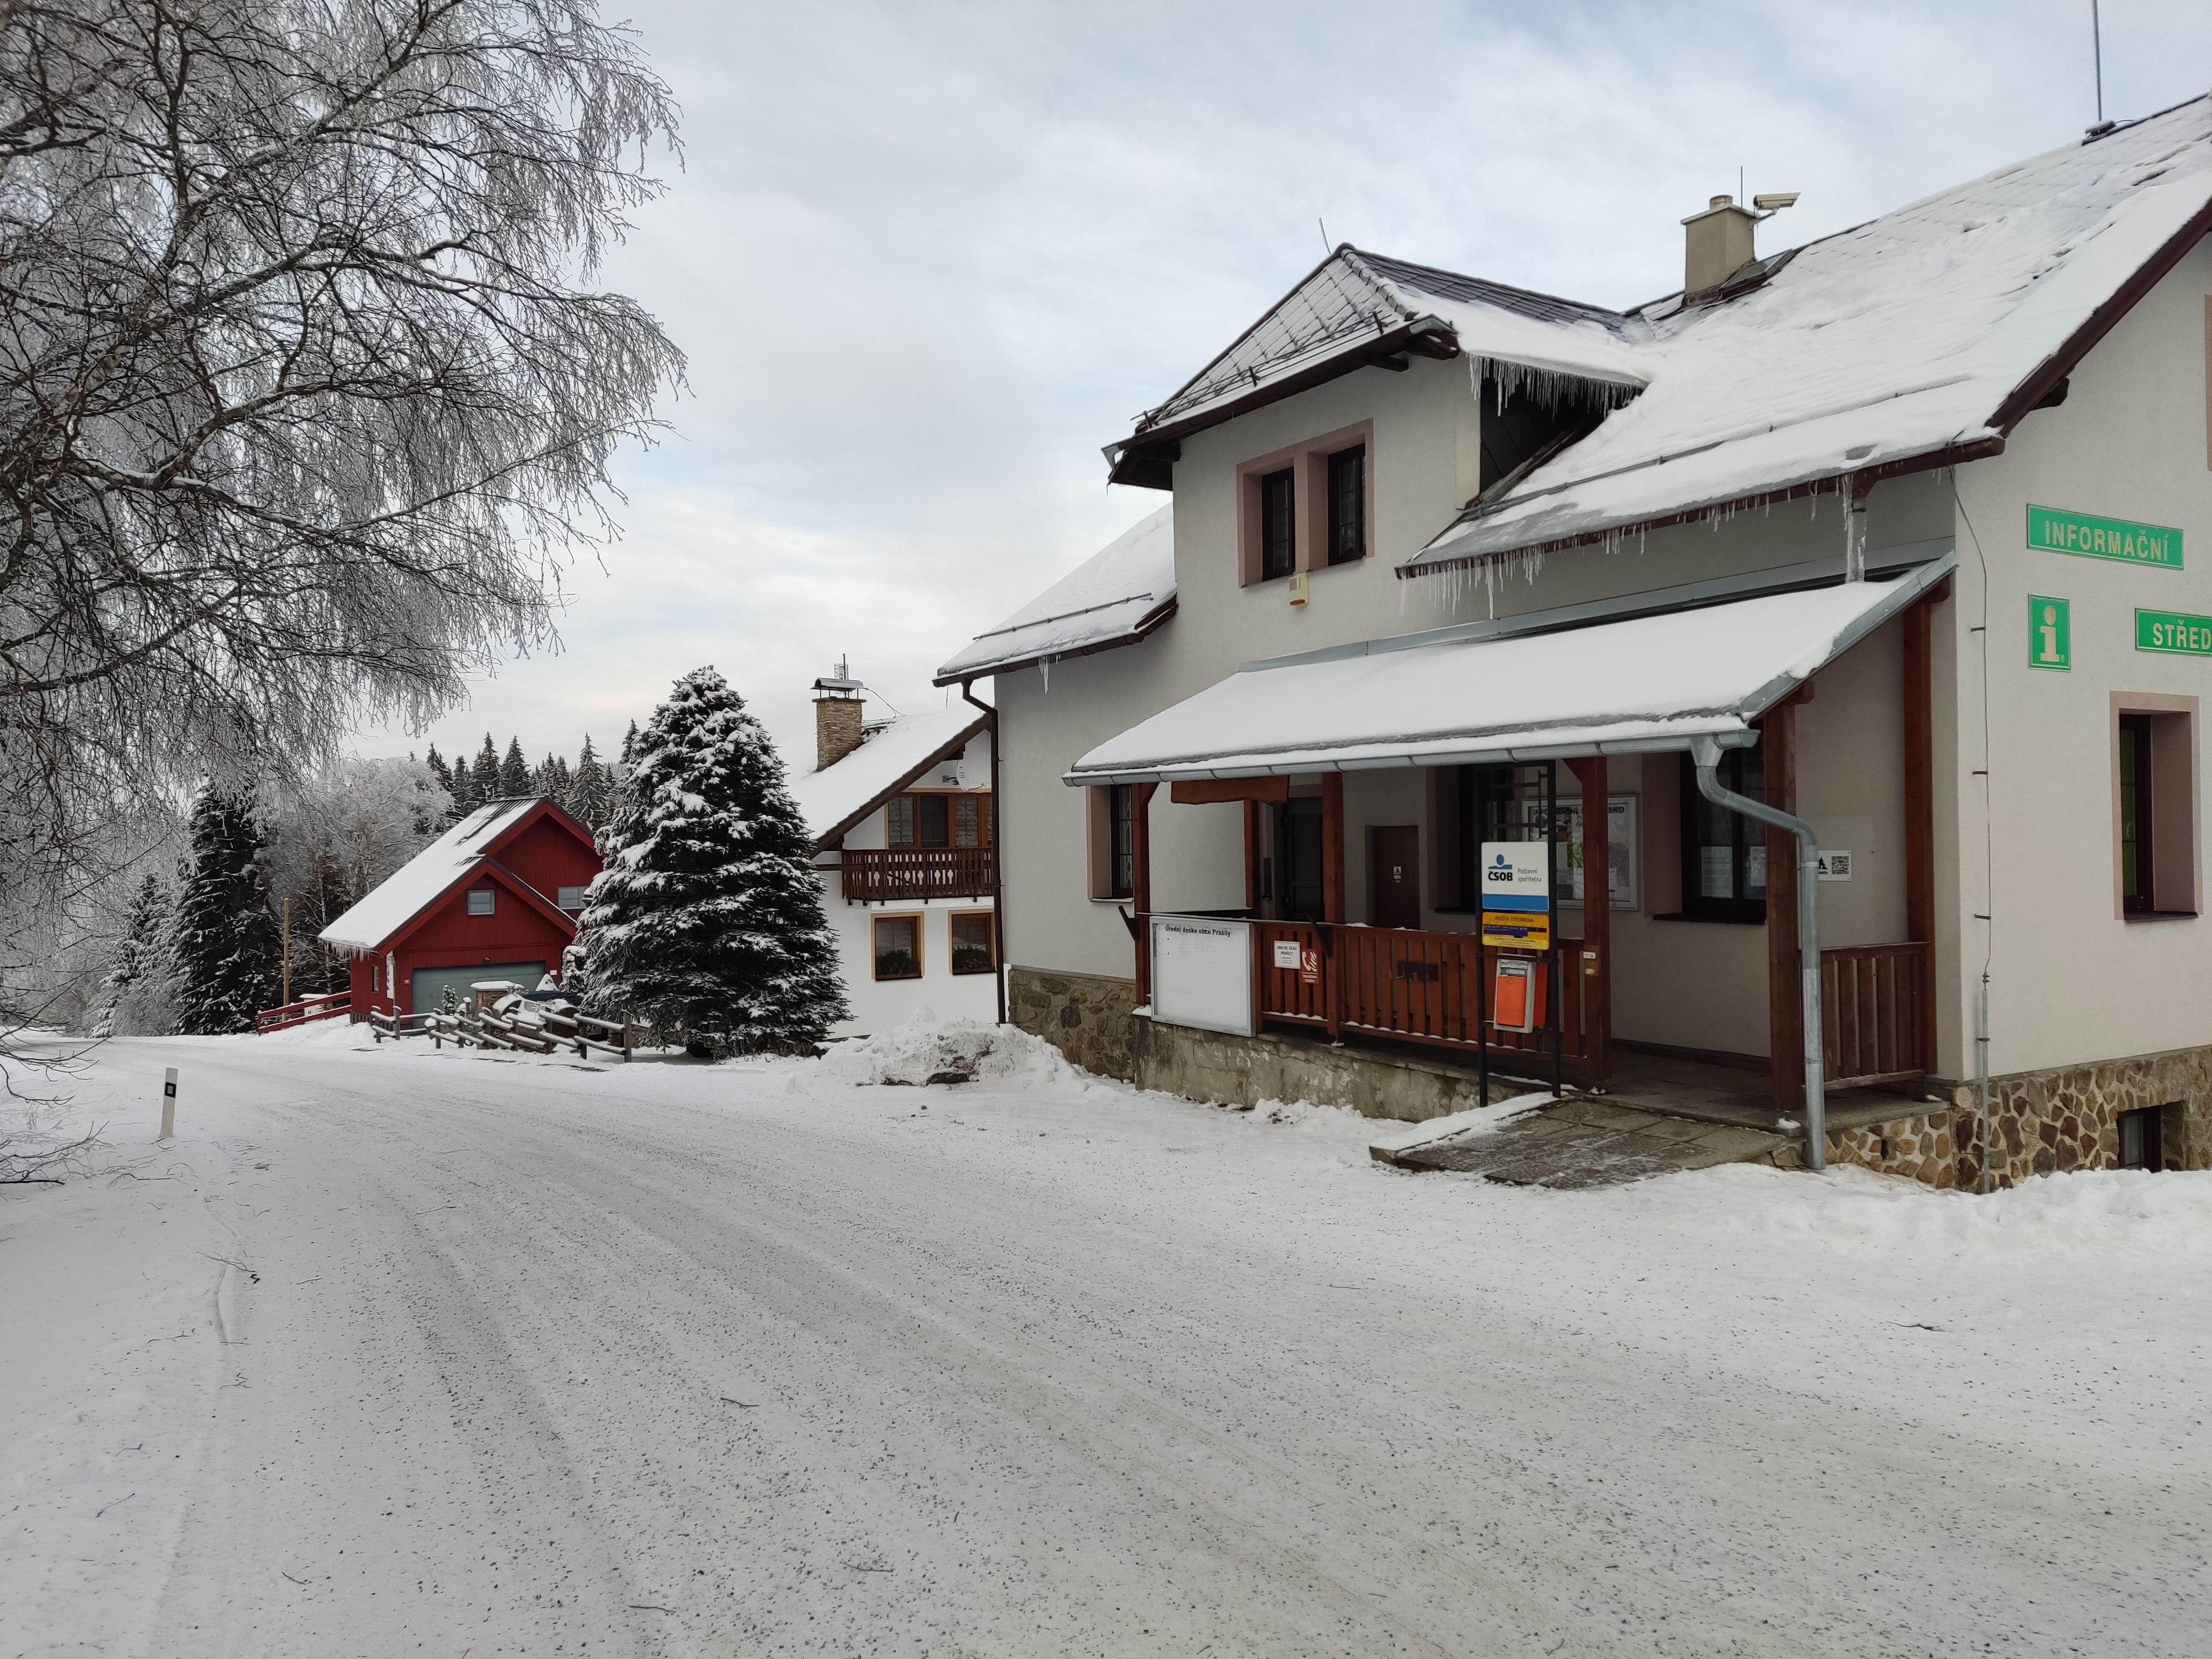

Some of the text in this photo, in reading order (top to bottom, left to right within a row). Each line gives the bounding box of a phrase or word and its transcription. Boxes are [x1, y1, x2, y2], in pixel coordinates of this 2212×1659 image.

[2044, 520, 2169, 561] INFORMAČNÍ
[2152, 619, 2212, 650] STŘED
[1488, 870, 1513, 881] ČSOB
[1165, 924, 1181, 932] Úřední
[1212, 929, 1231, 937] Prášily
